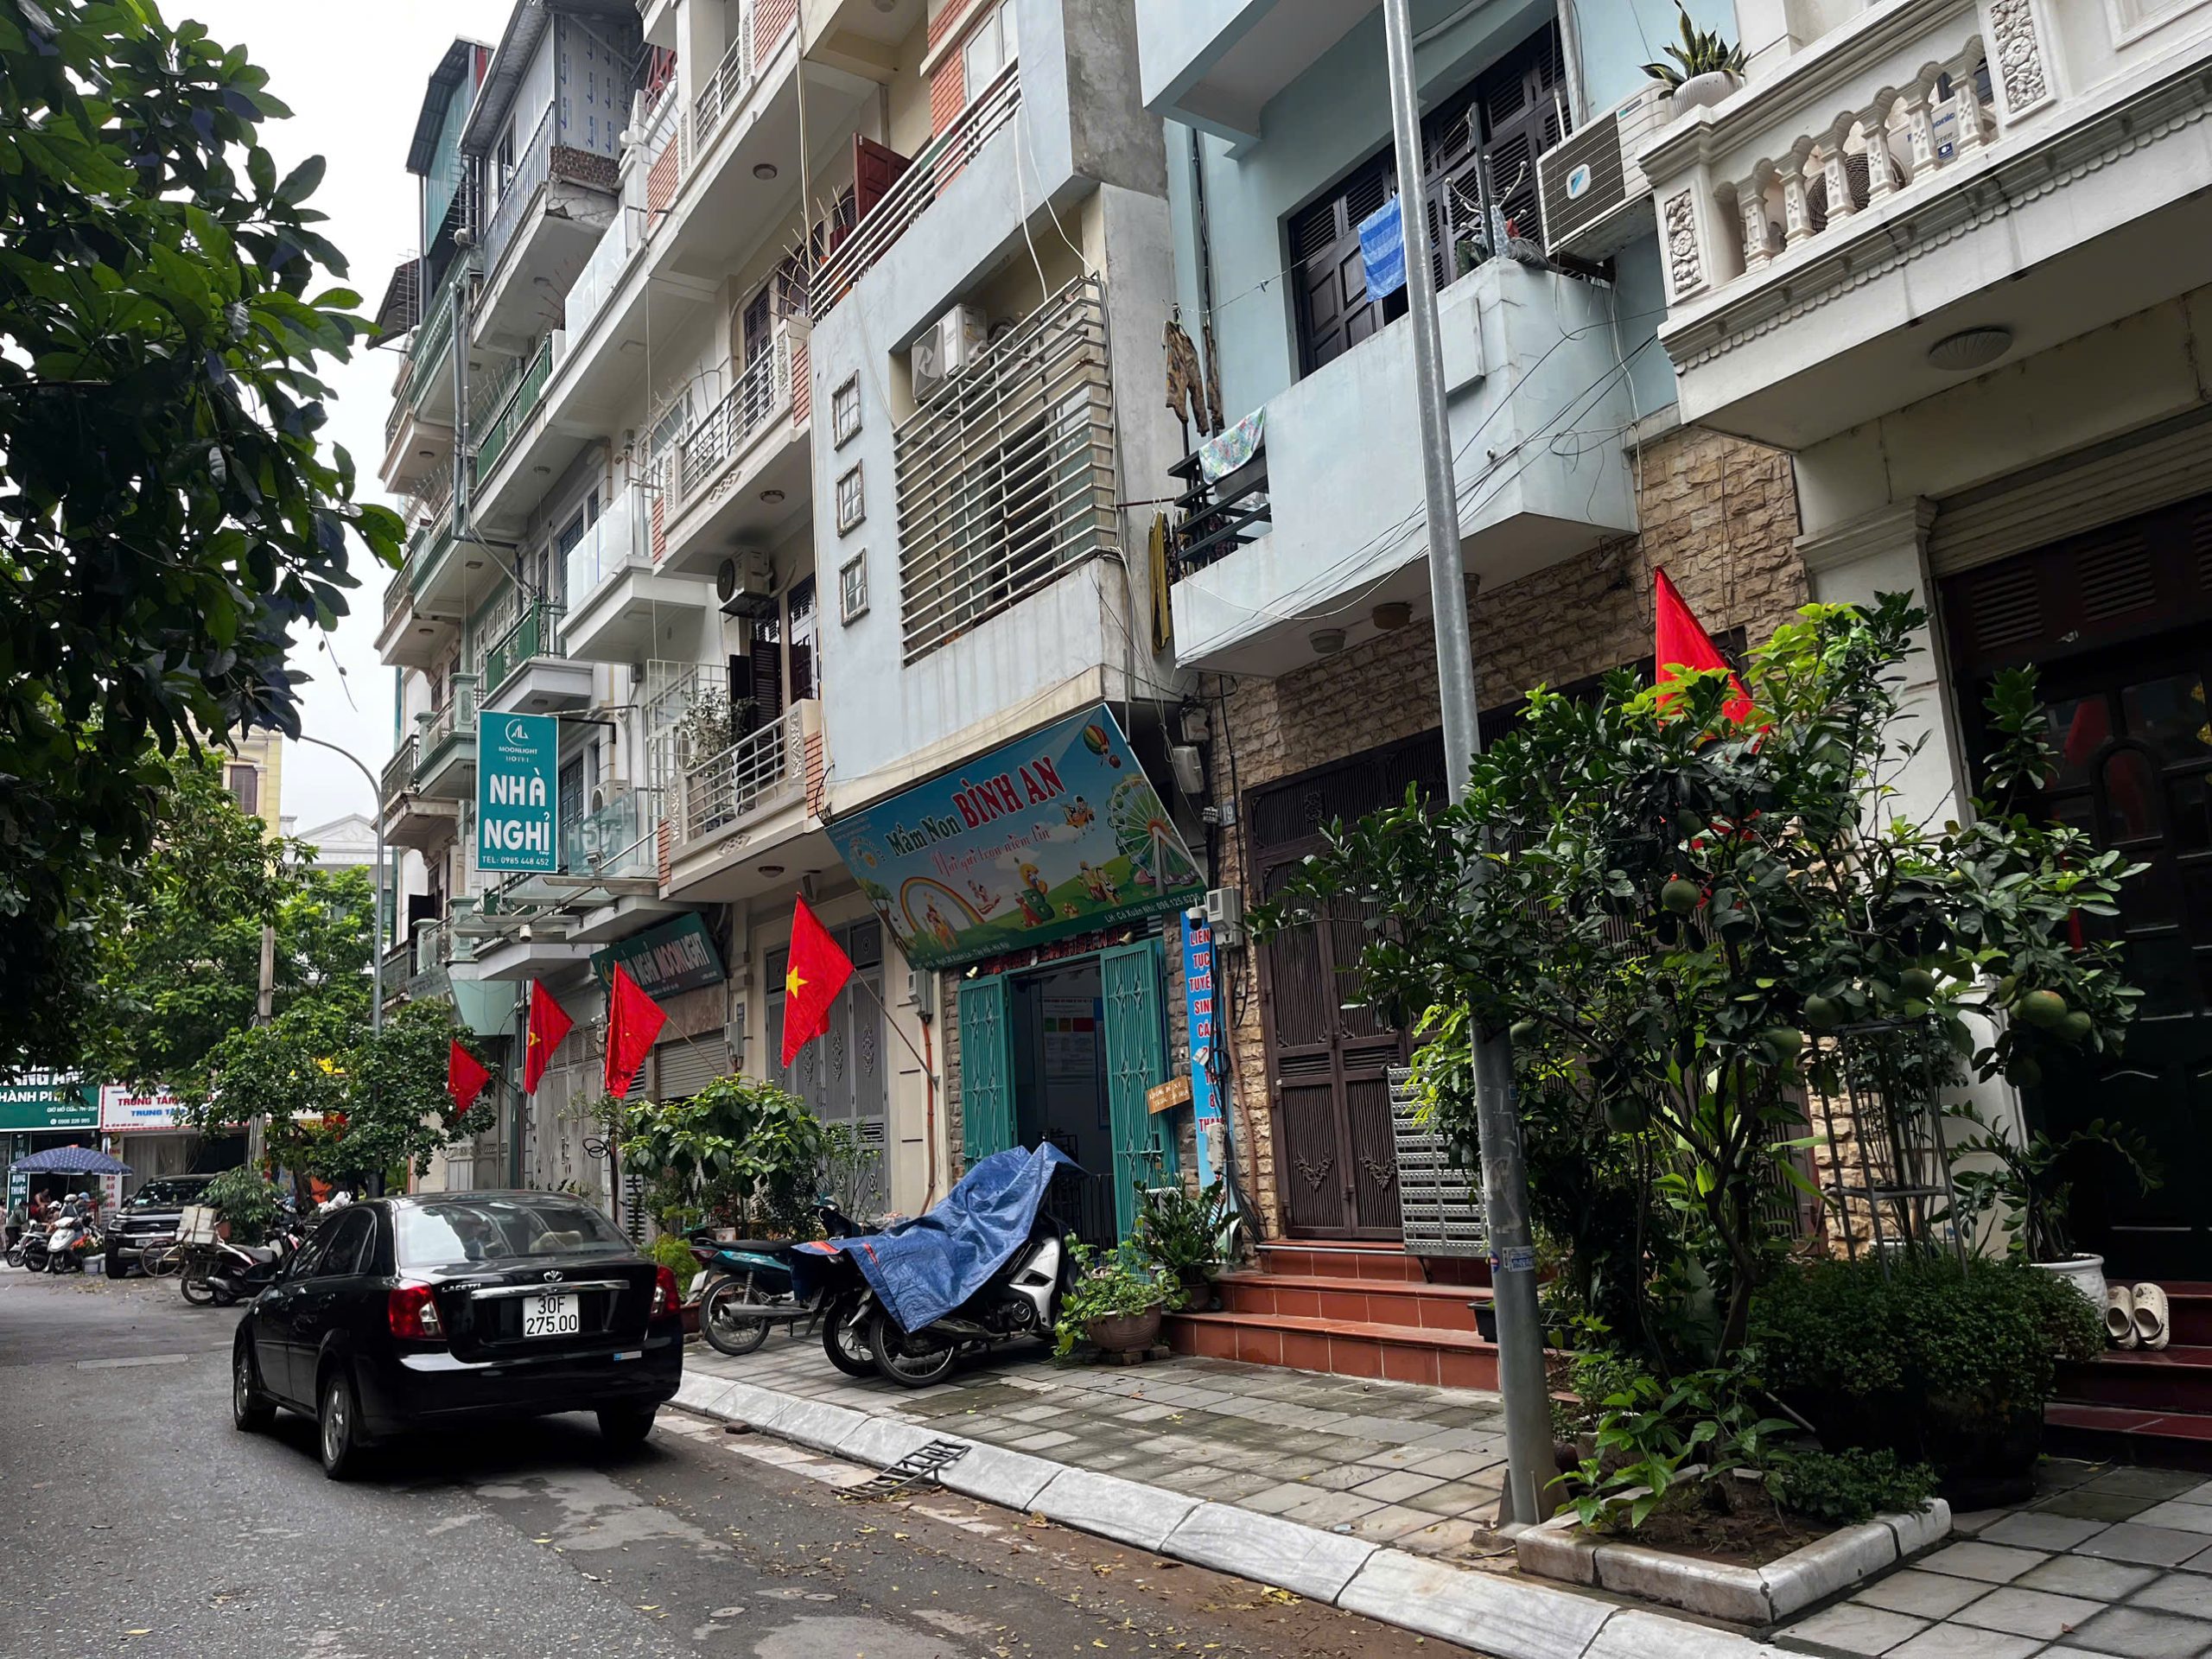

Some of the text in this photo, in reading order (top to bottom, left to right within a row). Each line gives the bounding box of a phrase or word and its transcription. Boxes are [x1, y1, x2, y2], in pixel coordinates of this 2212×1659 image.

[499, 746, 537, 754] MOONLIGHT
[490, 767, 546, 807] NHÀ
[953, 756, 1065, 830] BÌNH AN
[484, 811, 550, 851] NGHỈ
[885, 822, 928, 857] Mầm
[920, 816, 963, 844] Non
[482, 855, 550, 867] TEL: 0985 448 452
[652, 931, 710, 979] MOONLIGHT
[1194, 998, 1215, 1014] SIN
[118, 1096, 152, 1107] TRUNG
[442, 1282, 481, 1294] LACETTI
[537, 1296, 566, 1315] 30F
[525, 1313, 577, 1336] 275.00
